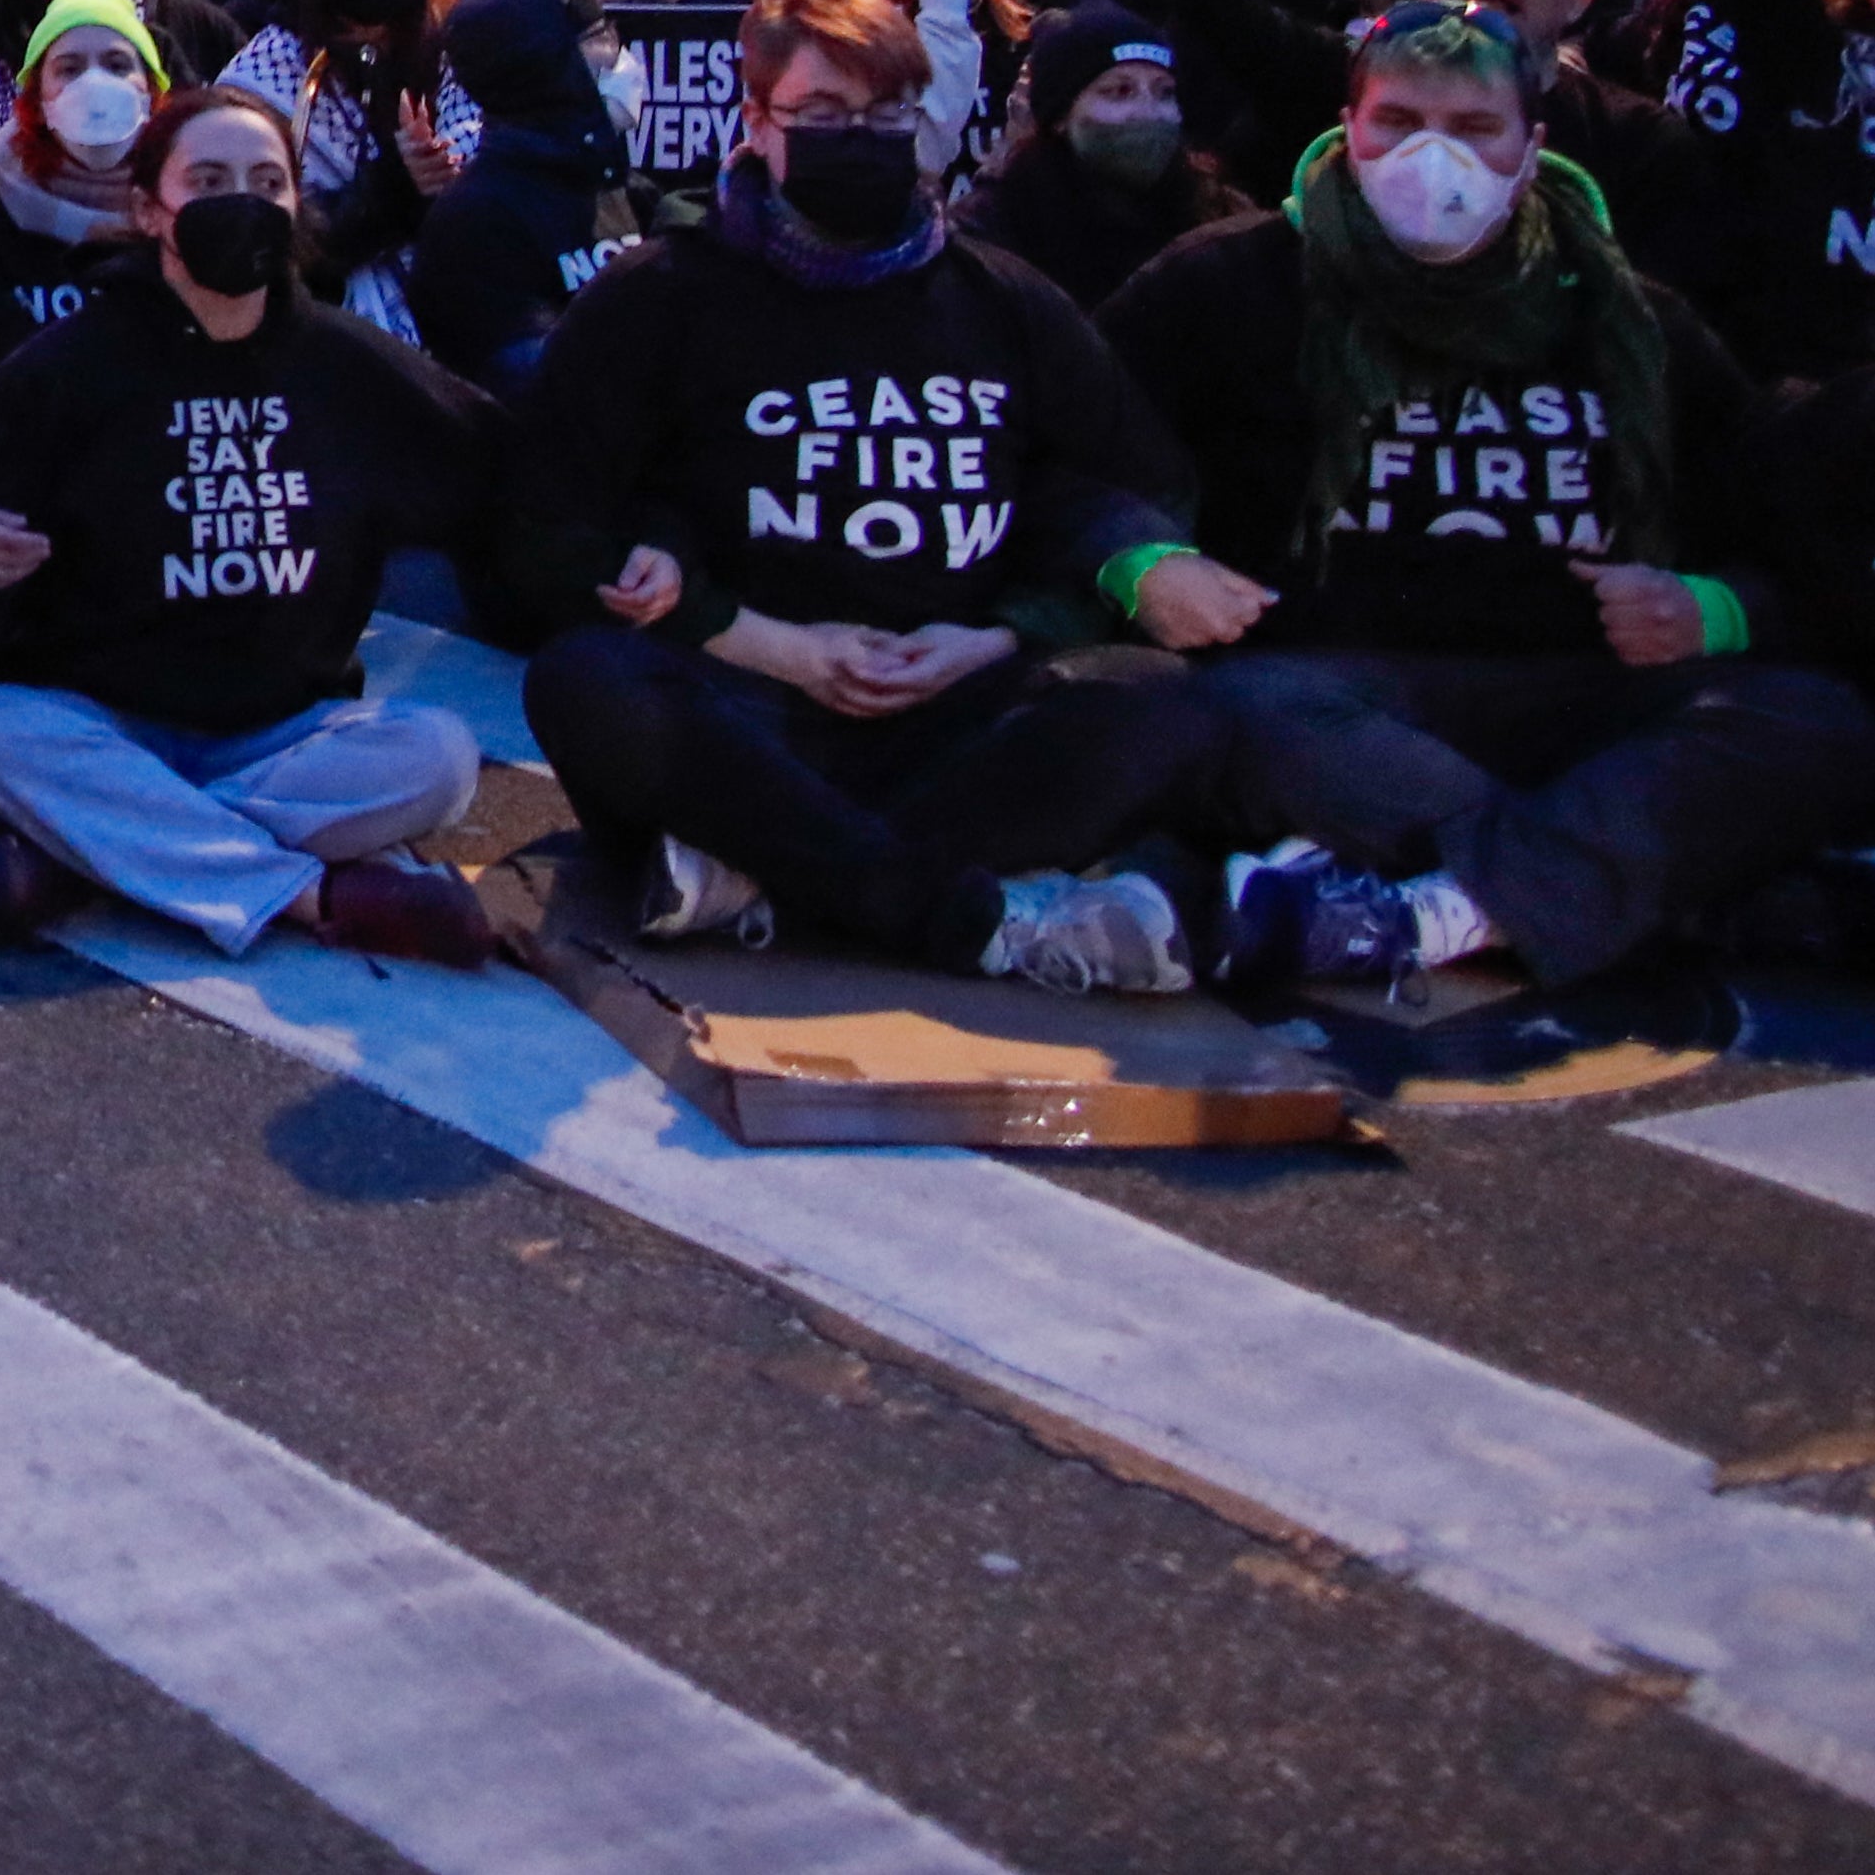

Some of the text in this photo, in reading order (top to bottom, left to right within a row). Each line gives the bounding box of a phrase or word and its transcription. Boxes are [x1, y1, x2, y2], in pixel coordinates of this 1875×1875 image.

[166, 395, 291, 437] JEWS
[744, 374, 1010, 437] CEASE
[187, 434, 276, 474] SAY
[796, 431, 989, 490] FIRE
[1368, 439, 1592, 502] FIRE
[164, 470, 311, 513] CEASE
[191, 509, 288, 549] FIRE
[748, 485, 1015, 570] NOW
[163, 548, 318, 599] NOW
